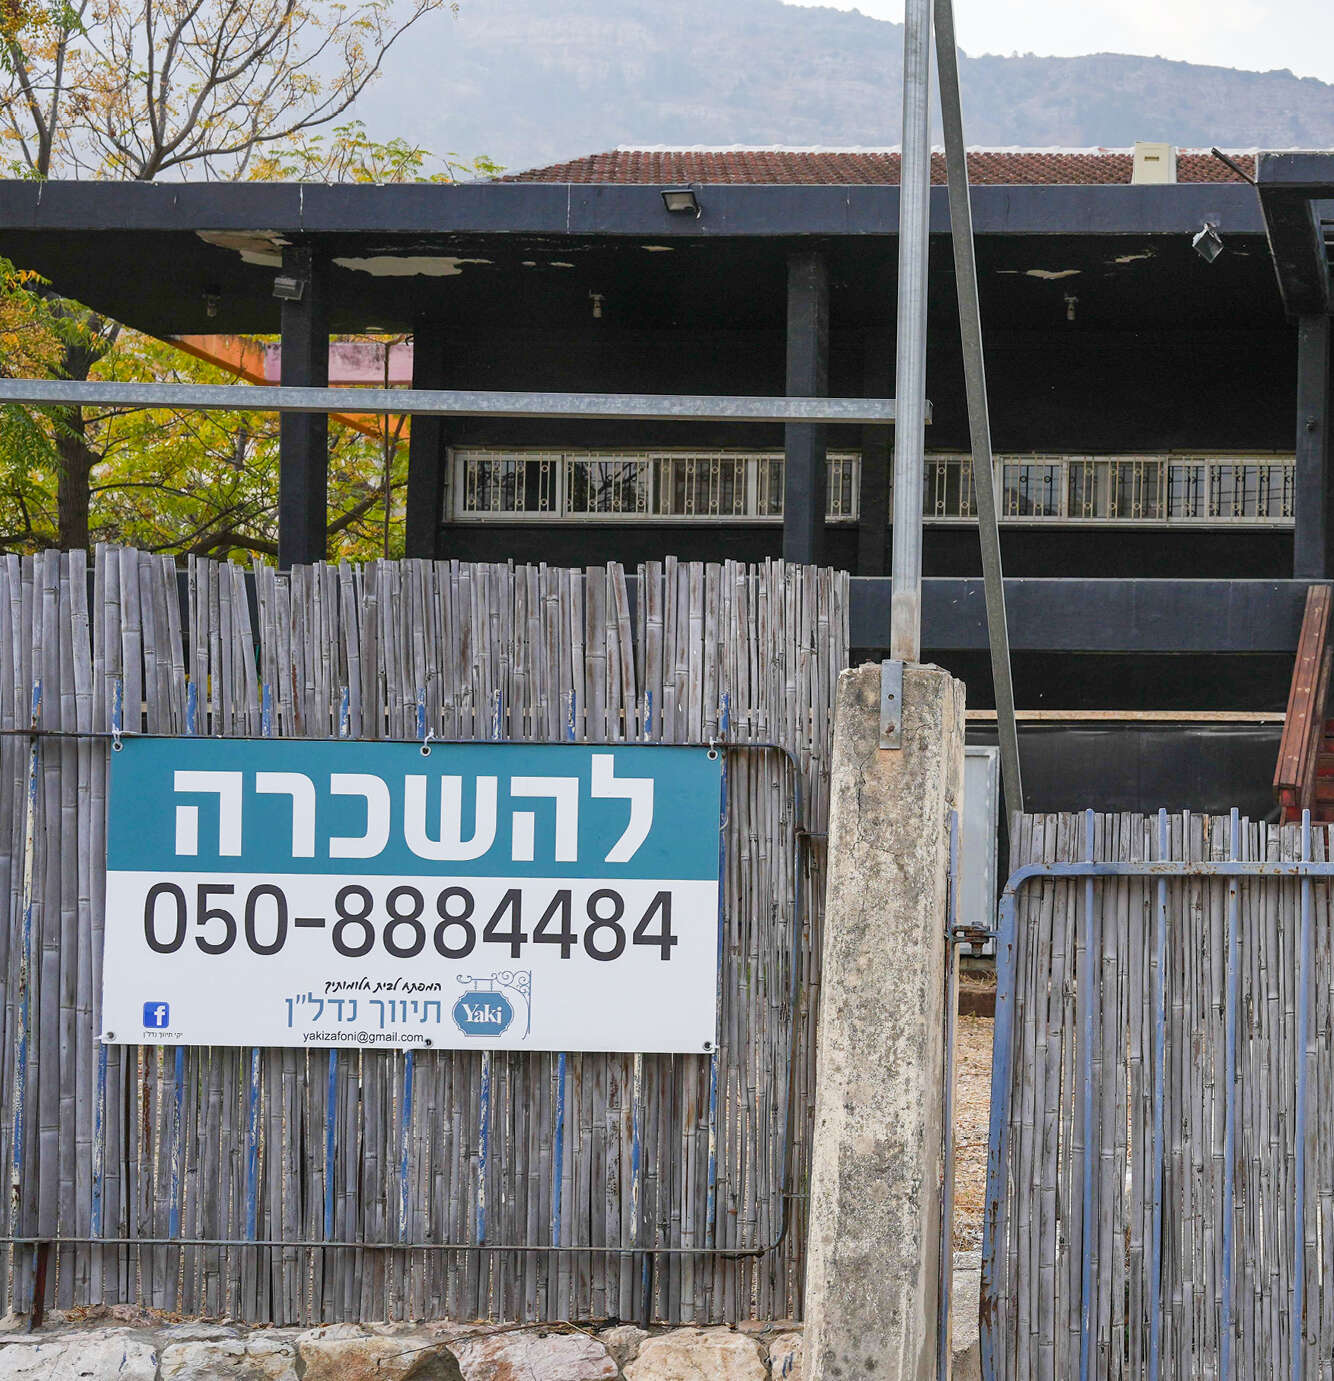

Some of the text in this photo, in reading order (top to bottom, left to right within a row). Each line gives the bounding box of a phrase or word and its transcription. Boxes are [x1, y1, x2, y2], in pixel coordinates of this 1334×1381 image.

[174, 754, 654, 863] להשכרה
[143, 882, 678, 962] 050-8884484
[324, 977, 442, 994] המפתח לבית חלומותיך
[368, 999, 442, 1029] תיווך
[461, 1003, 502, 1024] Yaki
[303, 1030, 424, 1044] yakizafoni@gmail.com
